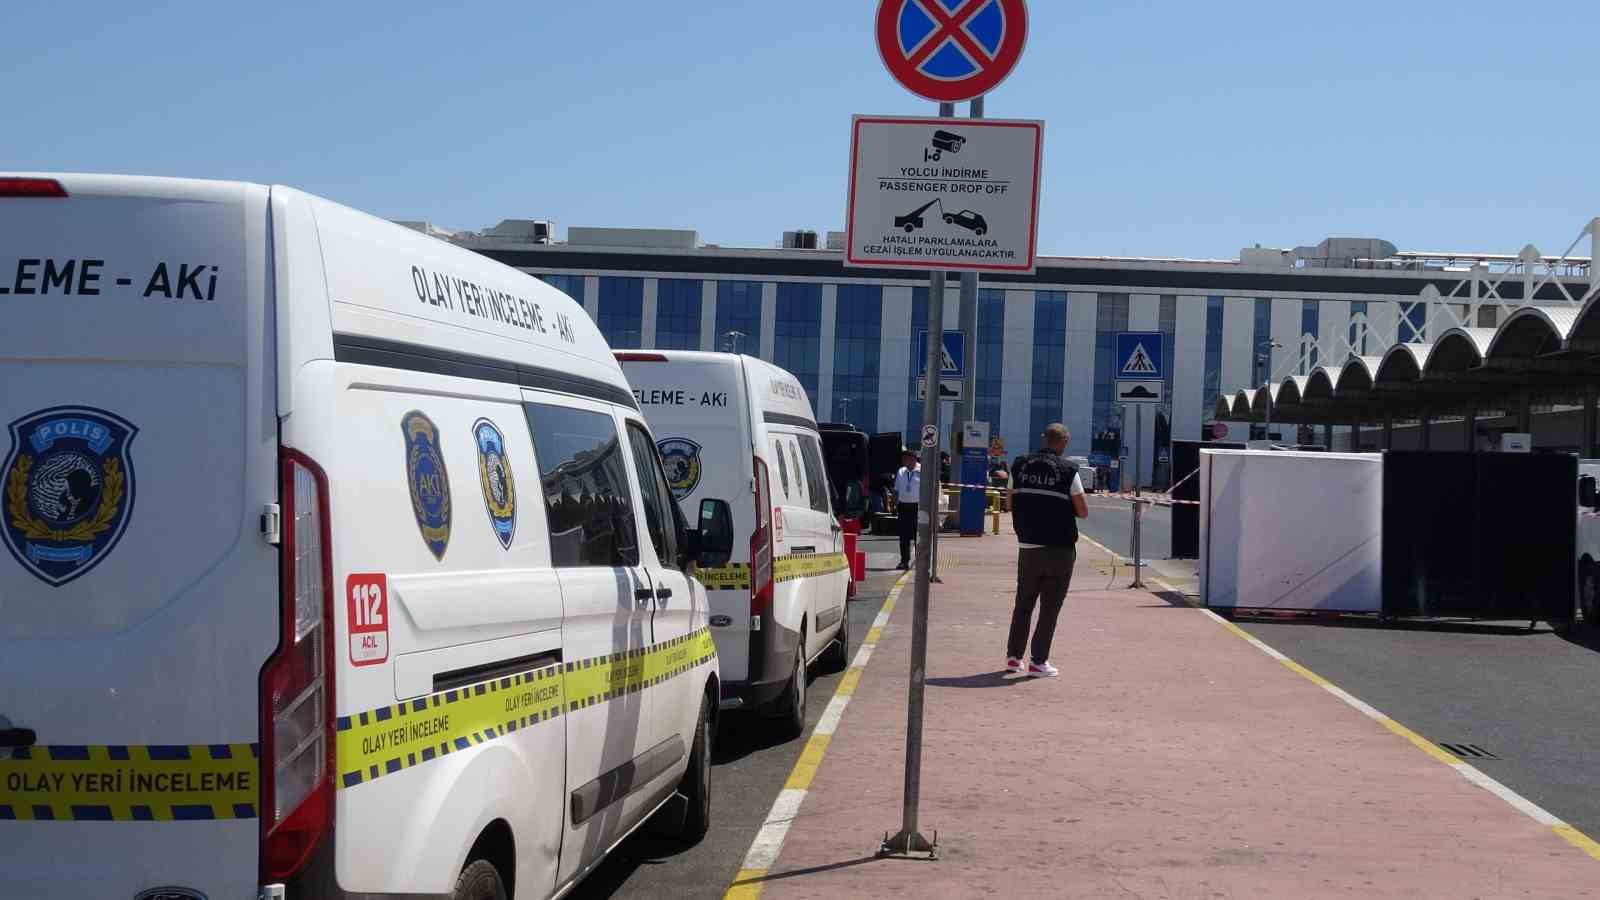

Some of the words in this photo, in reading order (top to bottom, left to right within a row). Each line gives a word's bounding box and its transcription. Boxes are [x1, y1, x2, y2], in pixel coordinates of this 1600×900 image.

[900, 167, 938, 177] YOLCU
[879, 181, 947, 192] PASSENGER
[951, 183, 982, 193] DROP
[985, 184, 1008, 194] OFF
[883, 236, 916, 245] HATALI
[919, 236, 998, 247] PARKLAMALARA
[116, 278, 131, 286] -
[411, 265, 453, 310] OLAY
[352, 583, 383, 626] 112
[362, 732, 387, 755] OLAY
[387, 722, 408, 748] YERİ
[409, 715, 449, 742] İNCELEME
[7, 772, 65, 792] OLAY
[71, 769, 122, 793] YERİ
[130, 769, 251, 792] İNCELEME
